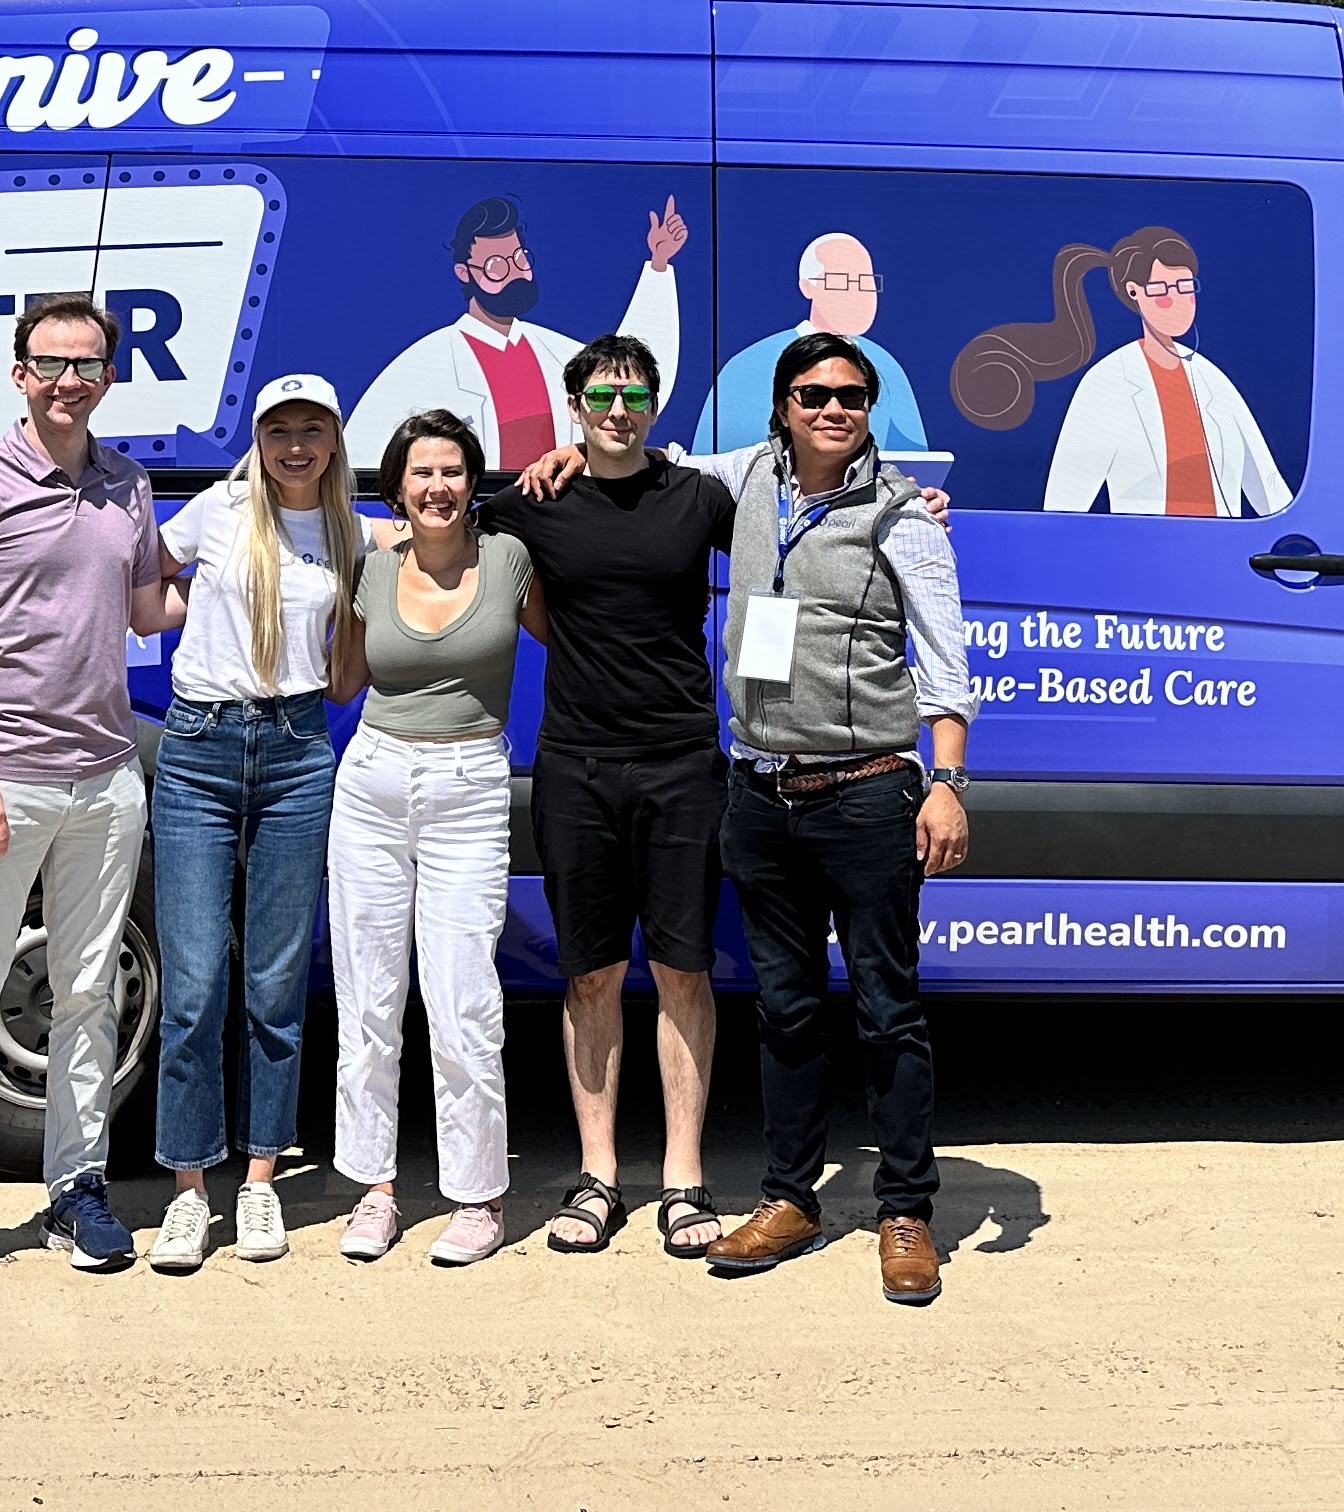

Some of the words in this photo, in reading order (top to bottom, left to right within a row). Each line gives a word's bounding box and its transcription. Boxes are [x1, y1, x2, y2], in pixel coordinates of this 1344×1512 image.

[963, 618, 1008, 659] ng
[1019, 610, 1083, 649] the
[1094, 614, 1226, 652] Future
[969, 666, 1154, 706] ue-Based
[1164, 669, 1257, 707] Care
